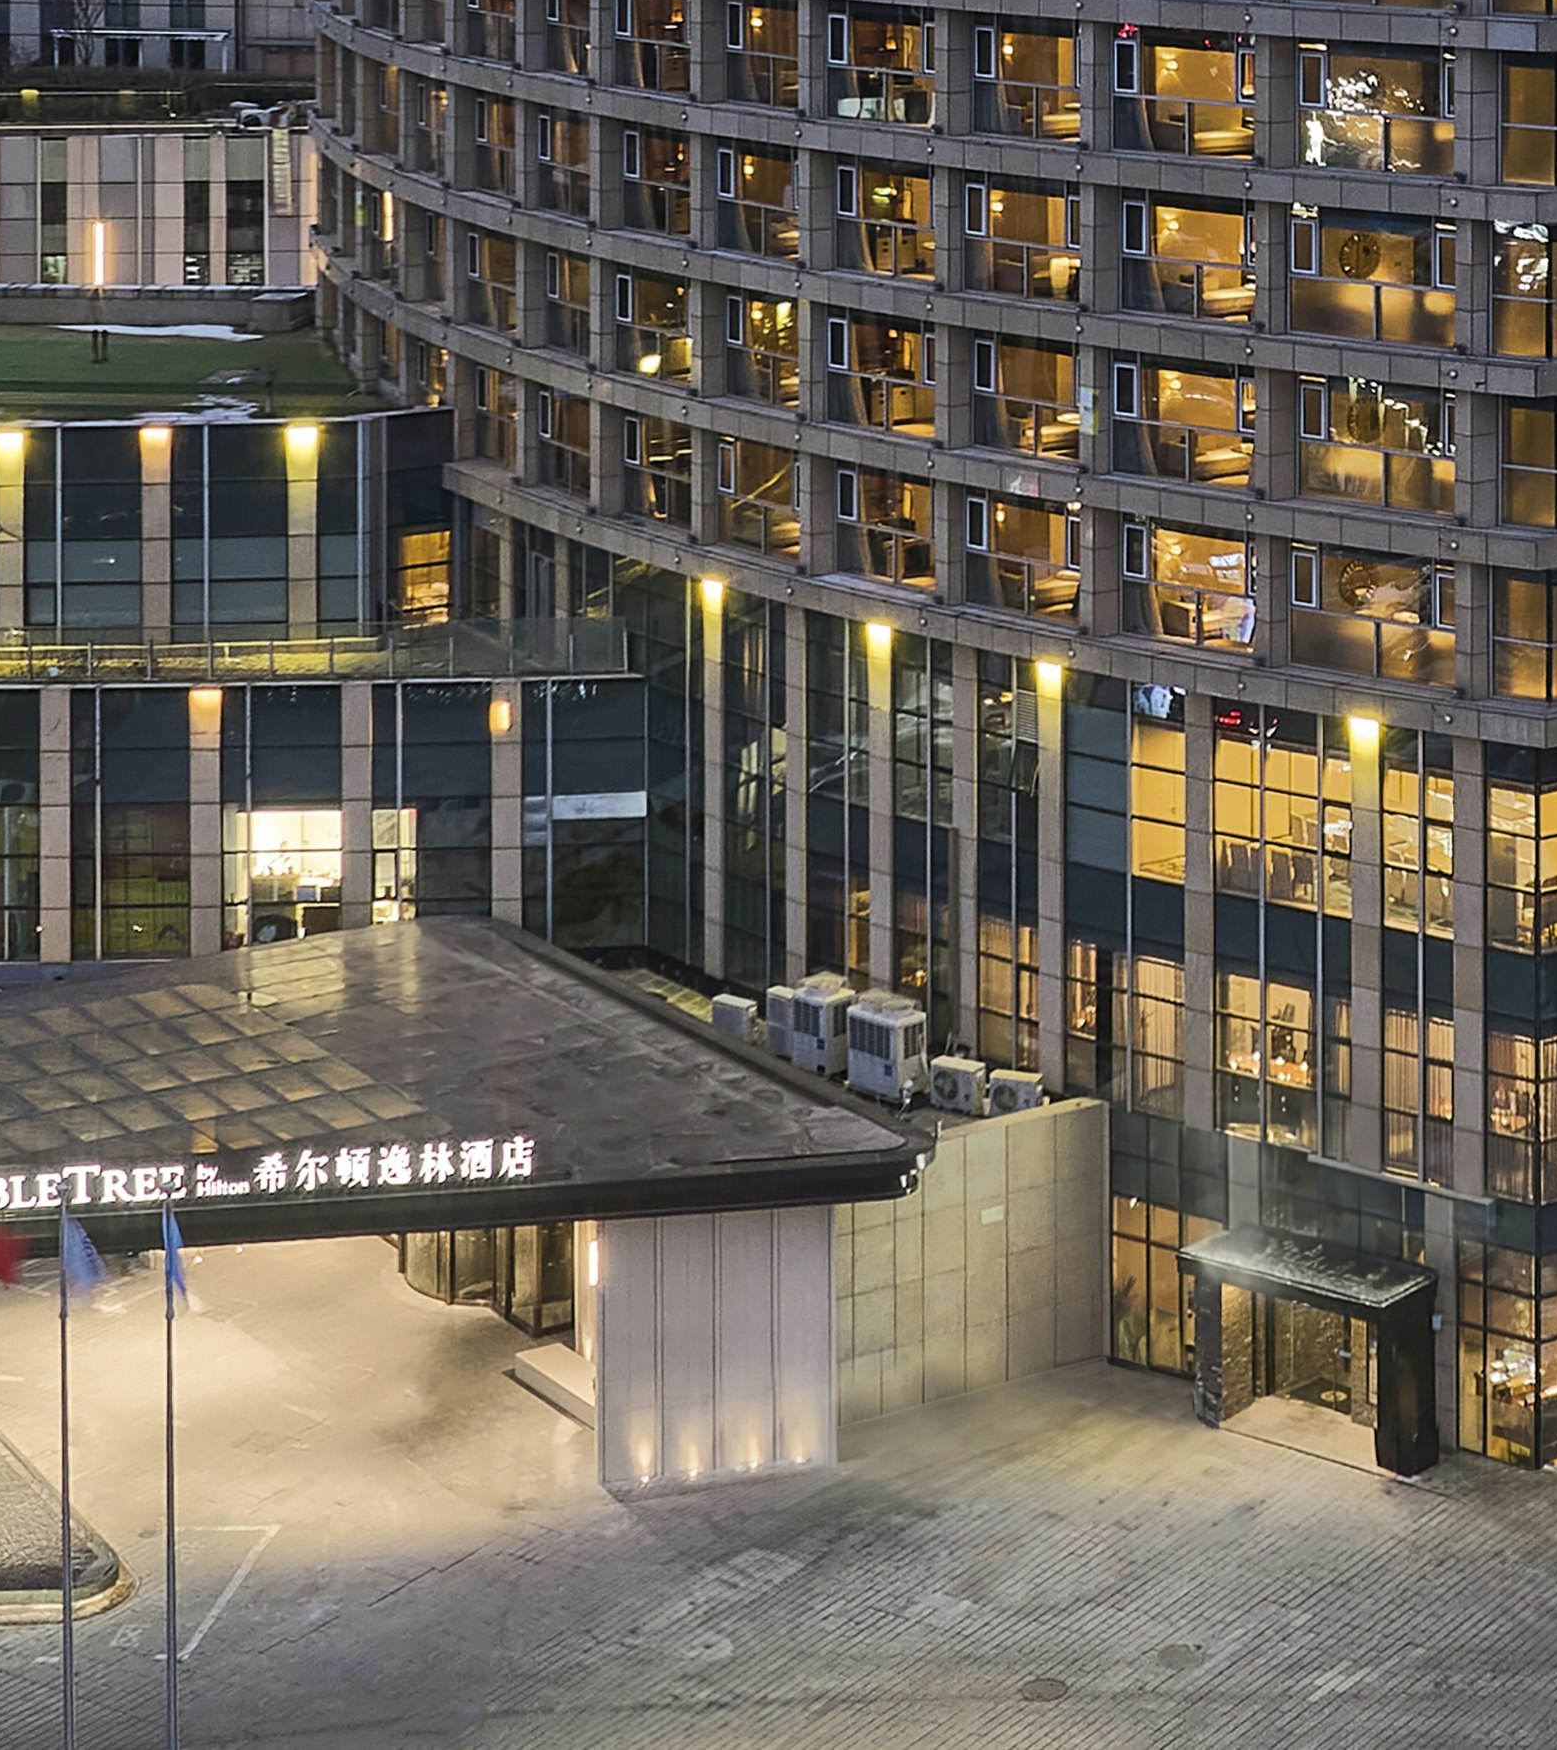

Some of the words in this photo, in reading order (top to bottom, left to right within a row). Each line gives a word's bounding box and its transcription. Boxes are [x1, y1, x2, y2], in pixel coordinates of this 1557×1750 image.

[196, 1163, 219, 1182] by
[252, 1134, 536, 1195] 希尔顿逸林酒店
[196, 1179, 251, 1197] Hilton
